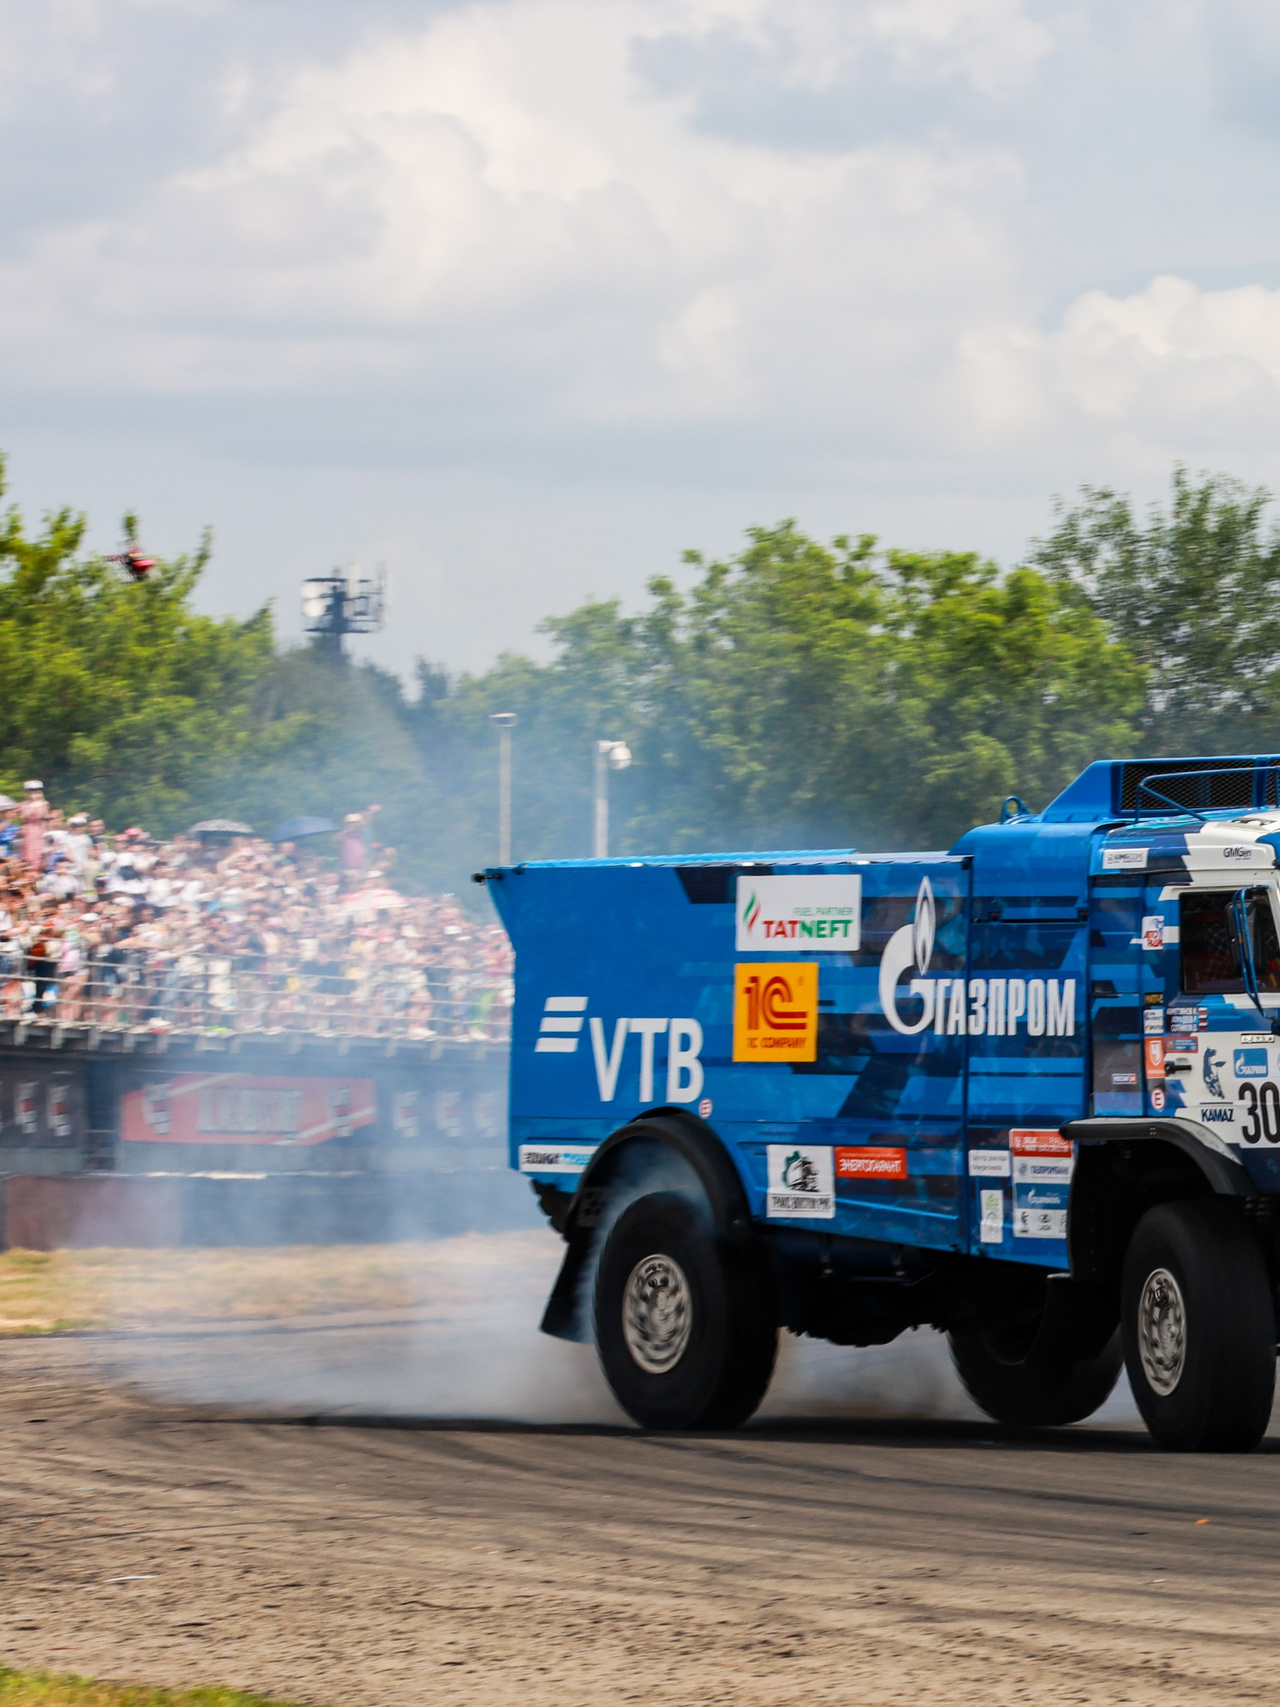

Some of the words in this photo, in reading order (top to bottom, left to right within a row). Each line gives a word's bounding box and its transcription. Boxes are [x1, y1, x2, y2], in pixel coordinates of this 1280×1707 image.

[762, 919, 853, 938] TATNEFT
[934, 978, 1076, 1036] ГАЗПРОМ
[589, 1017, 704, 1103] VTB
[1201, 1108, 1235, 1123] KAMAZ
